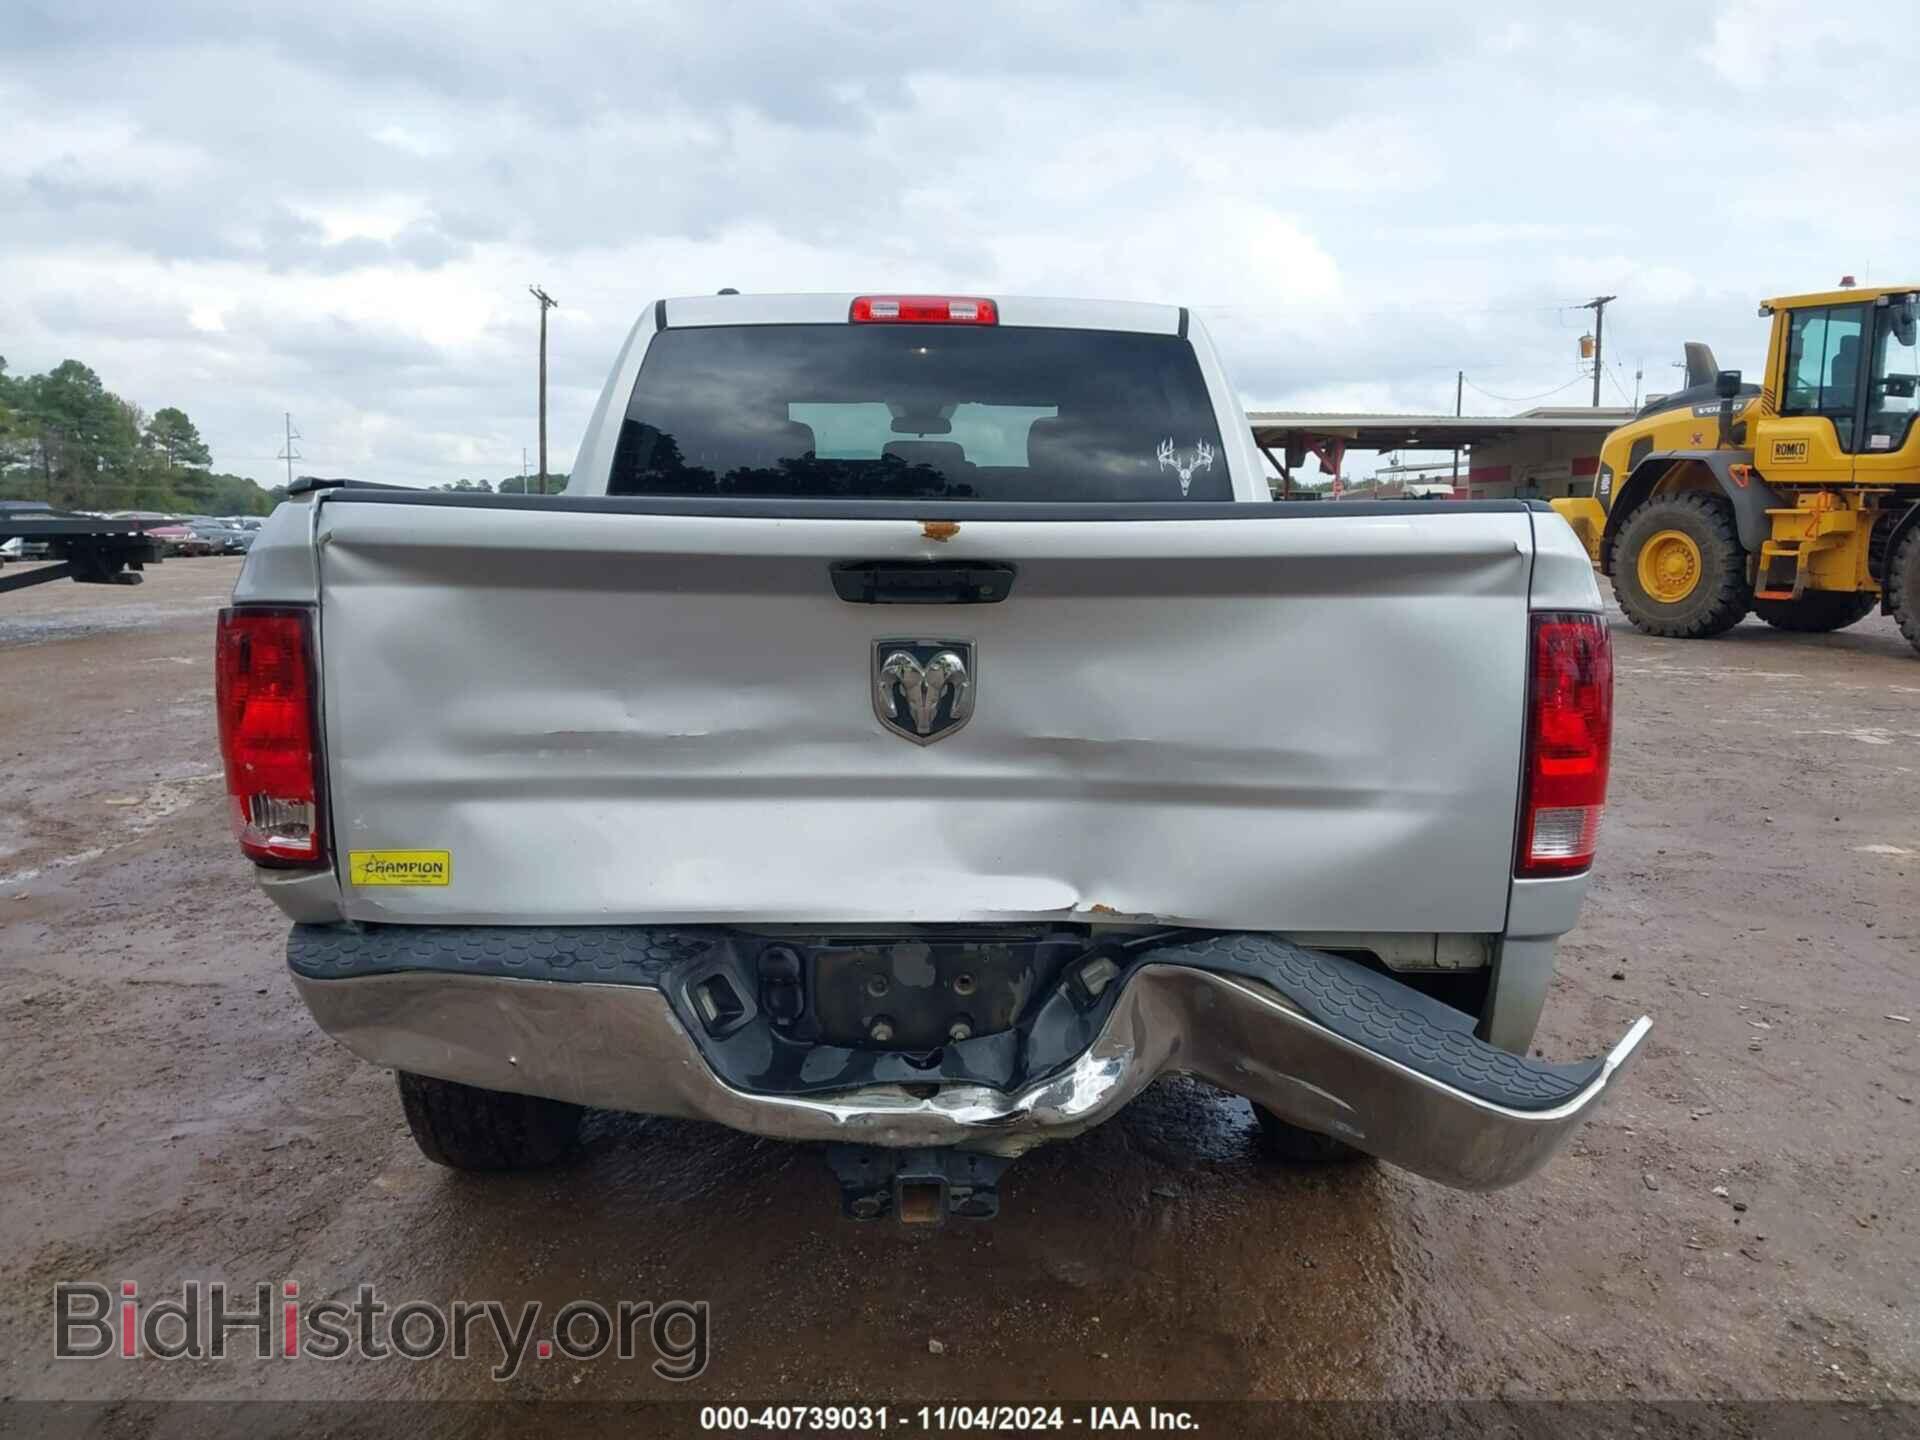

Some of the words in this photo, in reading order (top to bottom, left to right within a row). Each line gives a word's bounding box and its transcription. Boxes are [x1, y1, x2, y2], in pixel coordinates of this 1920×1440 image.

[1698, 403, 1743, 414] VOLO
[1775, 442, 1806, 456] ROMCO
[366, 862, 443, 873] CHAMPION
